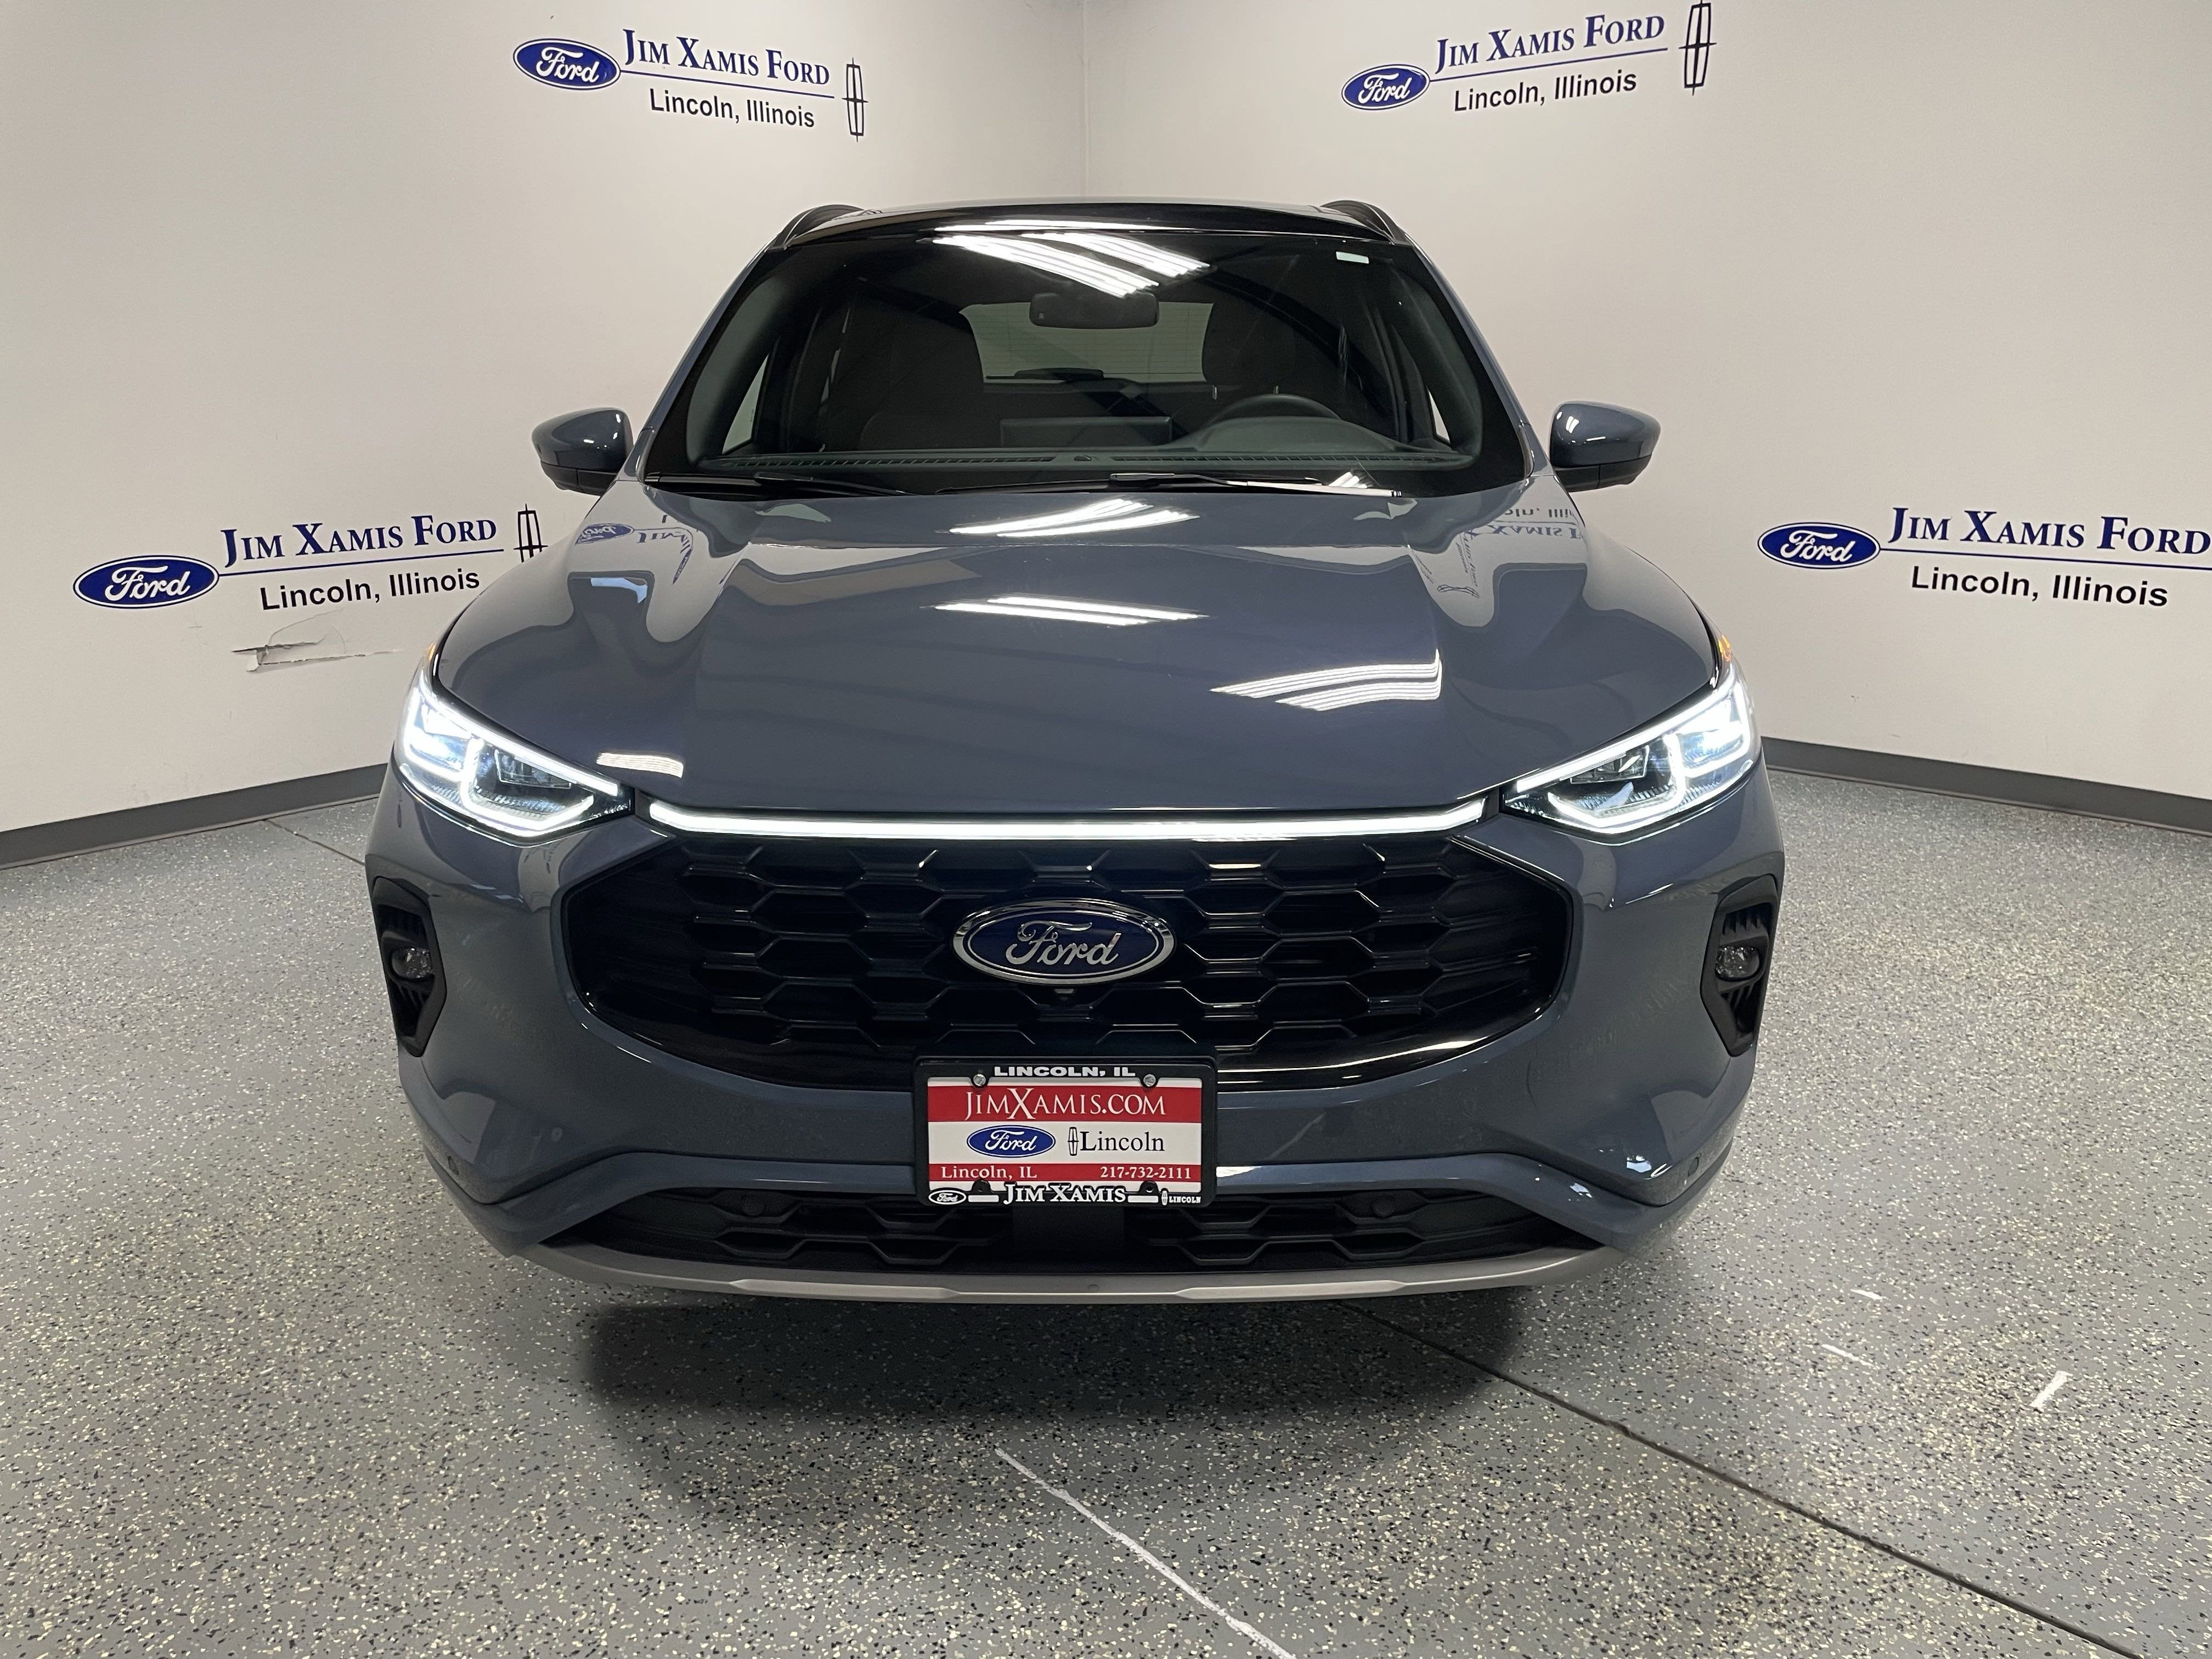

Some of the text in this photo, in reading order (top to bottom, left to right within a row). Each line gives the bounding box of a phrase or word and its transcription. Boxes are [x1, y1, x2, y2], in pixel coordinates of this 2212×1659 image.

[623, 29, 830, 85] JIM XAMIS FORD
[1435, 14, 1665, 74] JIM XAMIS FORD
[536, 47, 600, 83] Ford
[1358, 72, 1412, 103] Ford
[1454, 69, 1637, 112] Lincoln, Illinois
[650, 88, 815, 128] Lincoln, Illinois
[220, 515, 497, 568] JIM XAMIS FORD
[1780, 529, 1855, 563] Ford
[1888, 507, 2211, 555] JIM XAMIS FORD
[104, 566, 190, 600] Ford
[260, 568, 480, 611] Lincoln, Illinois
[1911, 566, 2169, 607] Lincoln, Illinois
[1005, 920, 1121, 966] Ford
[994, 1066, 1136, 1077] LINCOLN, IL
[964, 1088, 1166, 1120] JIMXAMIS.COM
[985, 1130, 1036, 1152] Ford
[1080, 1131, 1165, 1152] Lincoln
[941, 1166, 1037, 1180] Lincoln, IL
[1100, 1166, 1191, 1179] 217-732-2111
[936, 1193, 958, 1202] Ford
[1003, 1184, 1126, 1205] JIM XAMIS
